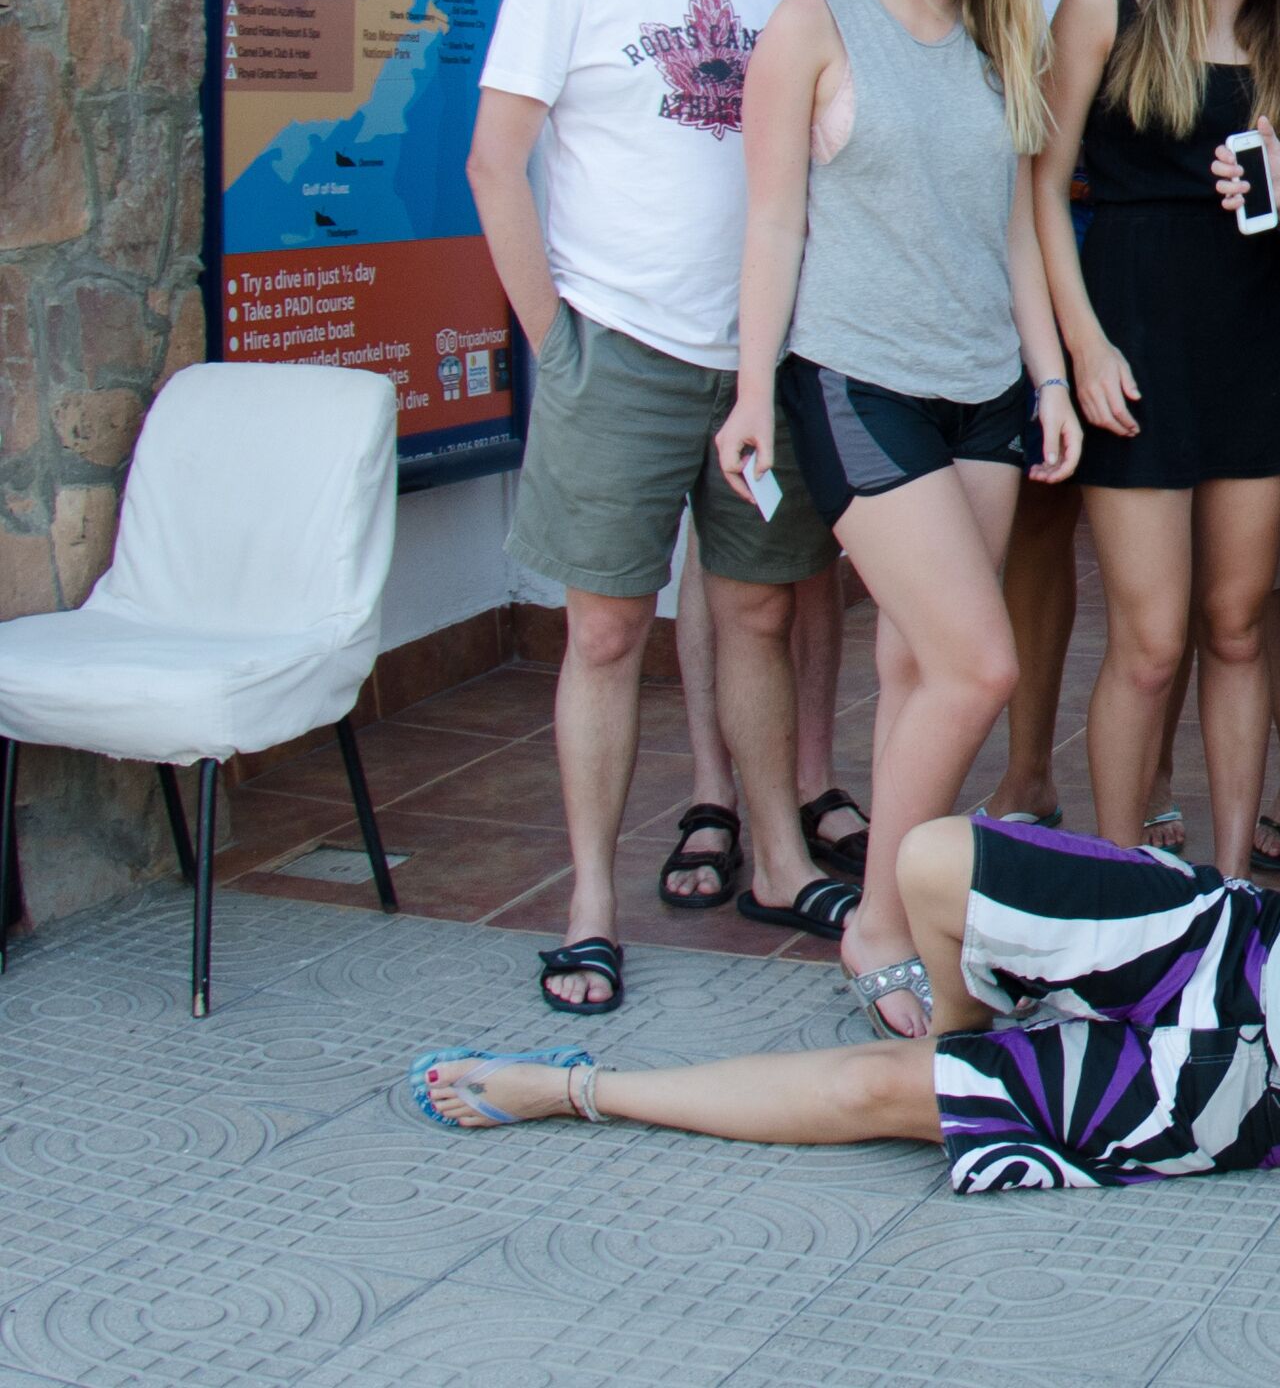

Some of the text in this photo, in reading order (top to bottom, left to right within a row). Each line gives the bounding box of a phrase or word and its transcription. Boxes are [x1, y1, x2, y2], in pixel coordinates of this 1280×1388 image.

[622, 25, 700, 67] ROOTS
[241, 272, 262, 297] Try
[264, 278, 272, 291] a
[274, 268, 301, 290] dive
[303, 268, 315, 287] in
[316, 266, 340, 291] just
[354, 262, 376, 286] day
[242, 295, 355, 322] Take a PADI course
[243, 321, 355, 351] Hire a private boat
[342, 342, 384, 366] snorkel
[385, 340, 411, 364] trips
[388, 368, 409, 386] ites
[406, 391, 429, 410] dive
